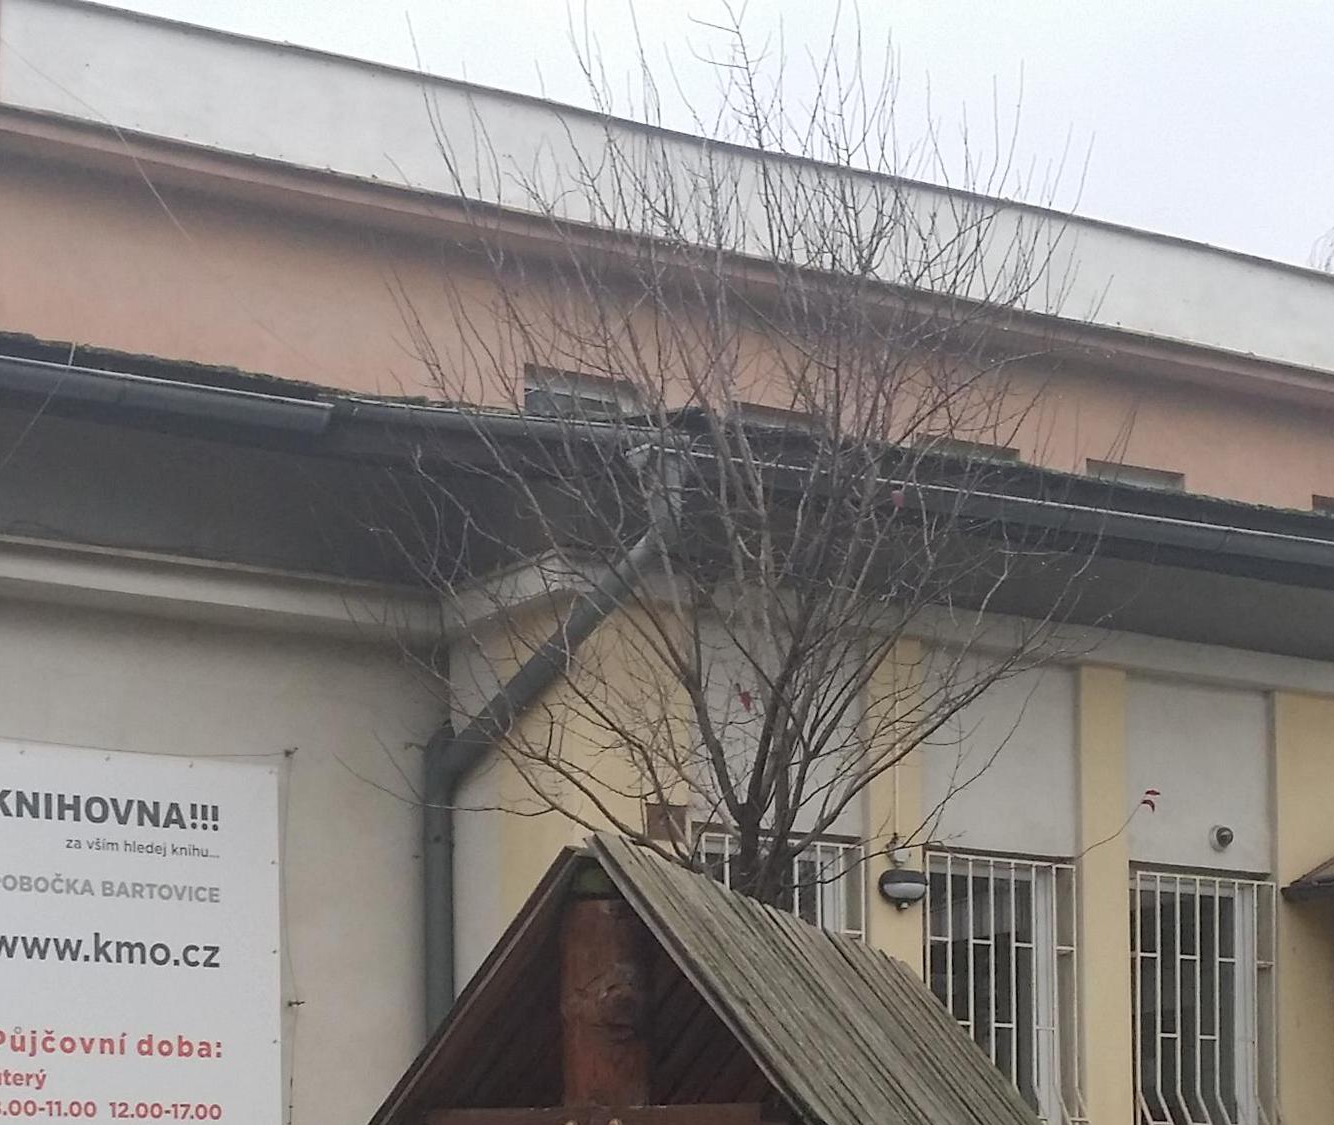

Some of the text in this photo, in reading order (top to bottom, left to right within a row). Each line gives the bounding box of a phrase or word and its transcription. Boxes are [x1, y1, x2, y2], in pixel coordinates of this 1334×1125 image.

[65, 838, 83, 850] za
[86, 837, 120, 852] vším
[123, 839, 167, 858] hledej
[101, 880, 221, 904] BARTOVICE
[136, 1033, 223, 1060] doba:
[108, 1101, 223, 1121] 12.00-17.00
